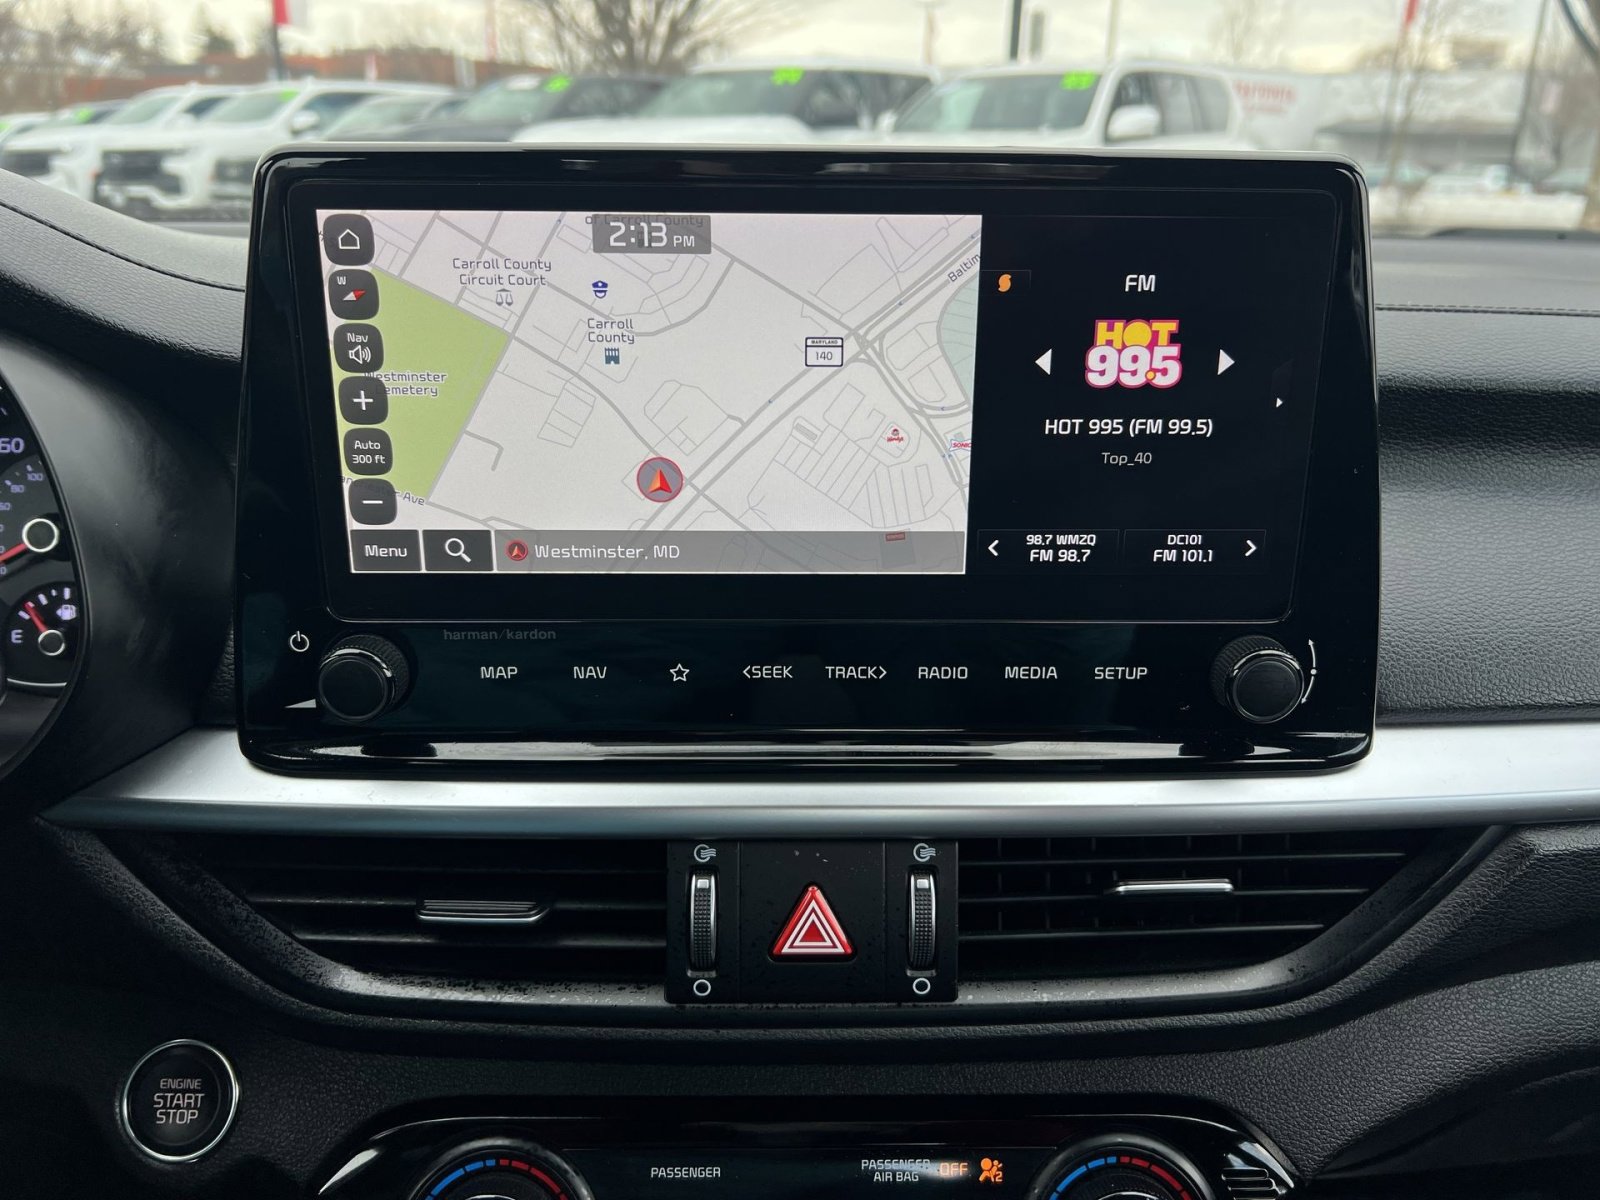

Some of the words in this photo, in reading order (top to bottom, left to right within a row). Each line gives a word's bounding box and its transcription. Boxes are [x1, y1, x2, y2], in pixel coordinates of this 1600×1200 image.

[609, 221, 668, 247] 2:13
[673, 235, 695, 247] PM
[452, 258, 500, 270] Carroll
[504, 258, 551, 272] County
[337, 276, 347, 285] W
[459, 274, 504, 286] Circuit
[508, 275, 546, 286] Court
[1125, 274, 1156, 292] FM
[587, 318, 634, 330] Carroll
[347, 333, 368, 343] Nav
[588, 331, 635, 344] County
[1095, 319, 1180, 347] HOT
[815, 351, 833, 361] 140
[1085, 344, 1182, 388] 99.5
[384, 385, 438, 397] emetery
[1045, 419, 1083, 435] HOT
[1088, 419, 1124, 435] 995
[1129, 419, 1162, 437] (FM
[1168, 419, 1213, 437] 99.5)
[354, 440, 381, 450] Auto
[352, 455, 372, 464] 300
[374, 454, 385, 464] ft
[1101, 452, 1152, 466] Top_40
[27, 473, 43, 481] 100
[402, 492, 425, 505] Ave
[1026, 534, 1053, 545] 98.7
[1056, 534, 1096, 546] WMZQ
[1167, 534, 1202, 545] DC101
[365, 544, 408, 558] Menu
[534, 545, 648, 560] Westminster,
[653, 545, 680, 559] MD
[1030, 550, 1053, 562] FM
[1058, 550, 1091, 562] 98.7
[1153, 550, 1176, 562] FM
[1182, 550, 1213, 562] 101.1
[11, 630, 23, 643] E
[443, 628, 557, 641] harman/kardon
[480, 666, 518, 679] MAP
[573, 666, 607, 679] NAV
[918, 666, 968, 680] RADIO
[1004, 666, 1058, 680] MEDIA
[1094, 667, 1148, 680] SETUP
[160, 1078, 202, 1090] ENGINE
[153, 1093, 205, 1108] START
[156, 1109, 199, 1124] STOP
[650, 1167, 721, 1178] PASSENGER
[861, 1159, 931, 1170] PASSENGER
[940, 1162, 968, 1176] OFF
[873, 1171, 893, 1182] AIR
[895, 1171, 920, 1182] BAG
